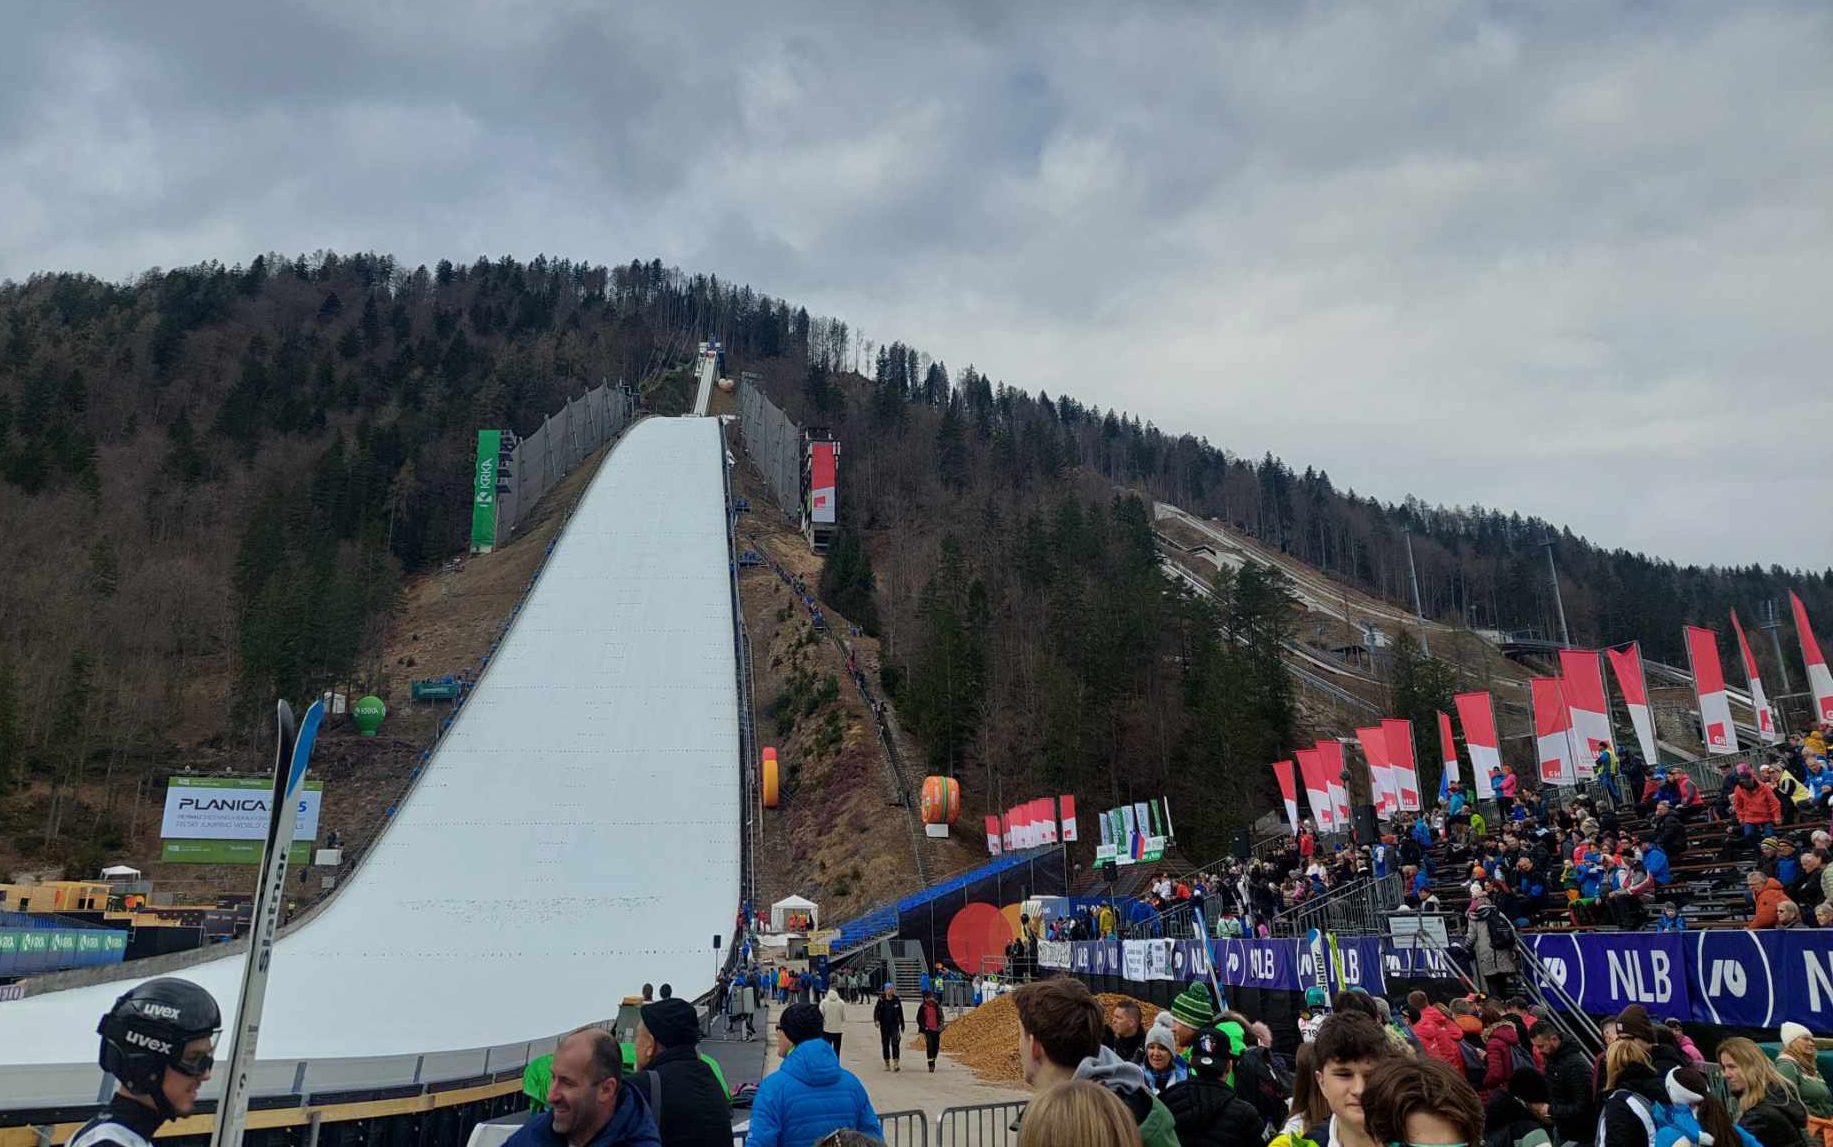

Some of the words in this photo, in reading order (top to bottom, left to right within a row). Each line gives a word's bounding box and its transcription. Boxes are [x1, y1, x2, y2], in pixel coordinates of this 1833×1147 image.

[480, 458, 493, 489] KRKA
[178, 798, 267, 811] PLANICA
[1249, 948, 1274, 979] NLB
[1607, 949, 1672, 1003] NLB
[143, 1003, 181, 1020] uvex
[125, 1030, 172, 1055] uvex
